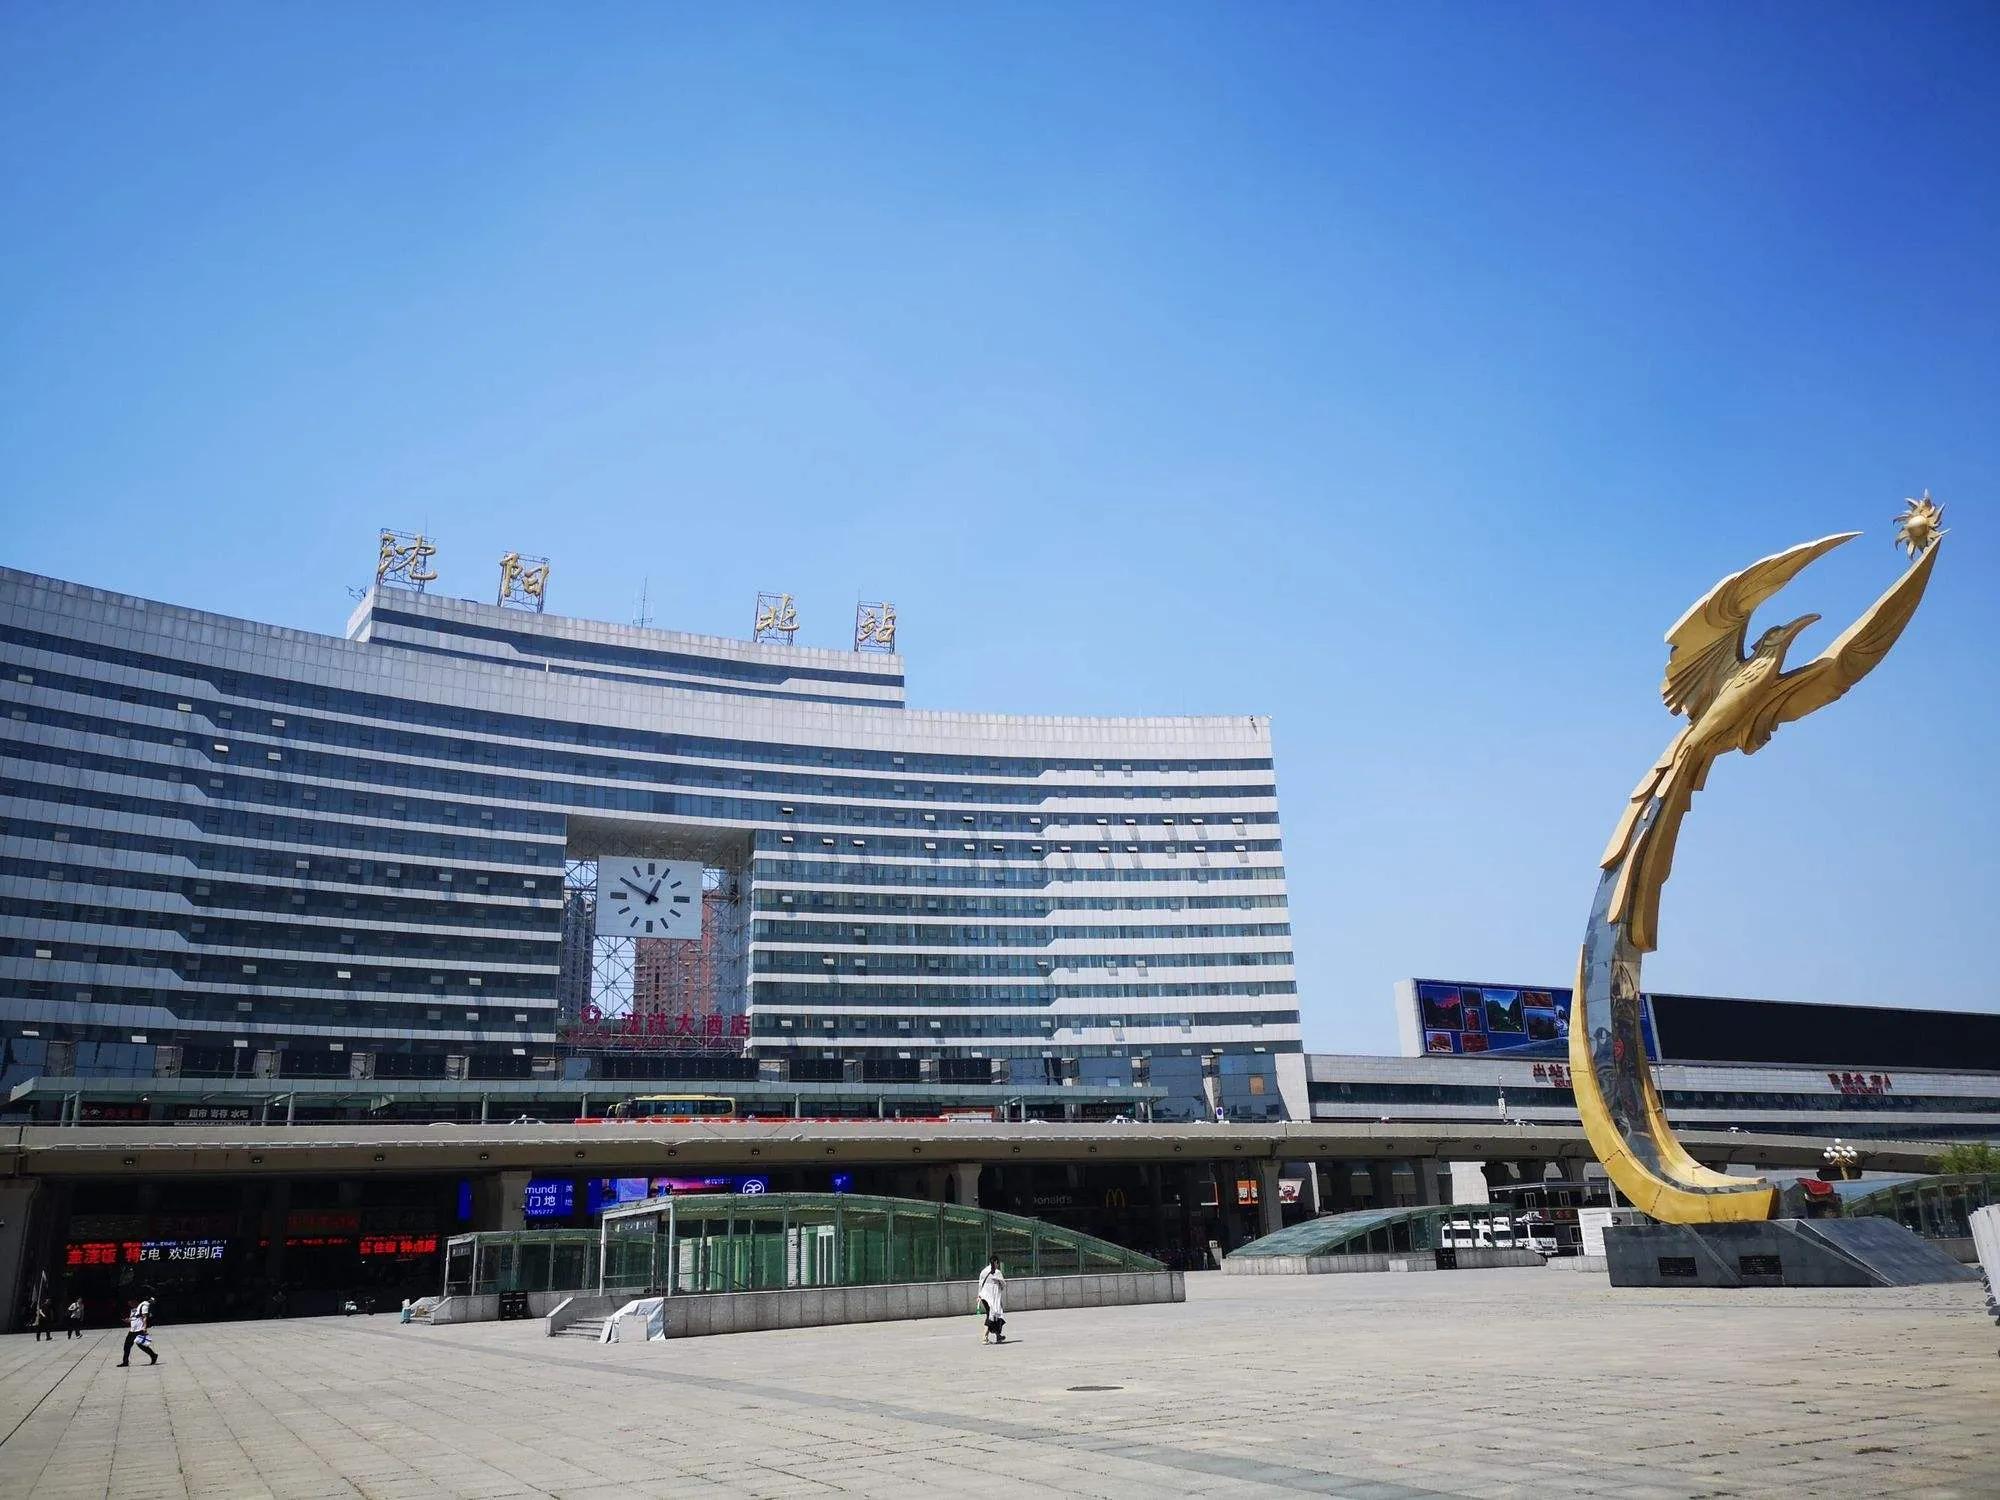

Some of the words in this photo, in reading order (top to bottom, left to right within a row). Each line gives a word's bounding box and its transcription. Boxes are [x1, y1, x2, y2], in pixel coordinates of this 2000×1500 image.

[378, 534, 896, 643] 沈阳北站
[1533, 1063, 1571, 1078] 出站
[189, 1108, 207, 1118] 超市
[168, 1245, 225, 1260] 欢迎到店
